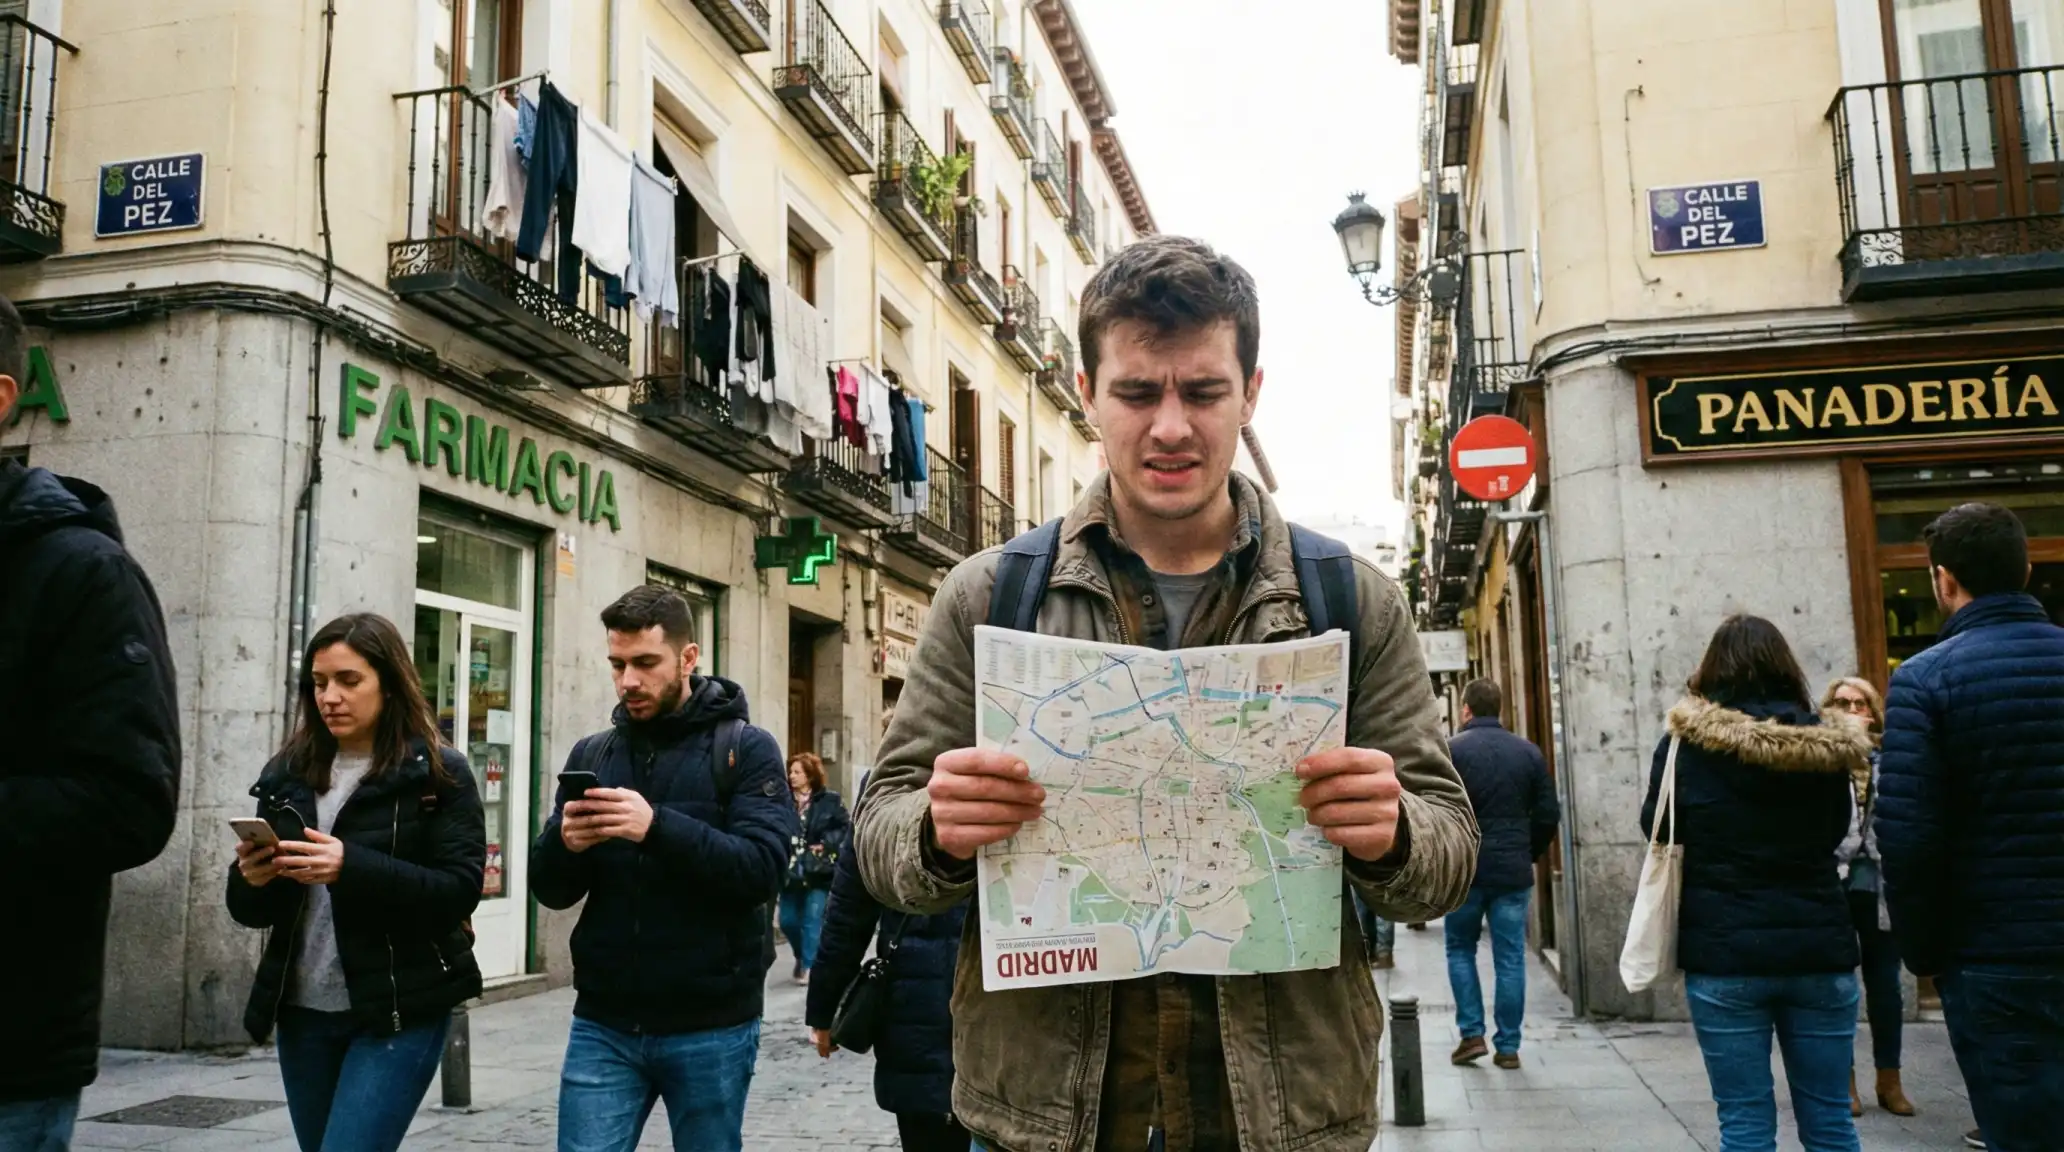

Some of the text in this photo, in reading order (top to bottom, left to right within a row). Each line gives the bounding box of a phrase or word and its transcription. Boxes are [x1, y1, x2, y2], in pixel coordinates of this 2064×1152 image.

[131, 158, 192, 181] CALLE
[133, 182, 168, 201] DEL
[1684, 185, 1748, 205] CALLE
[124, 200, 173, 228] PEZ
[1687, 205, 1727, 223] DEL
[1681, 221, 1736, 247] PEZ
[1696, 364, 2060, 435] PANADERÍA
[338, 362, 622, 532] FARMACIA
[997, 946, 1098, 978] MADRID
